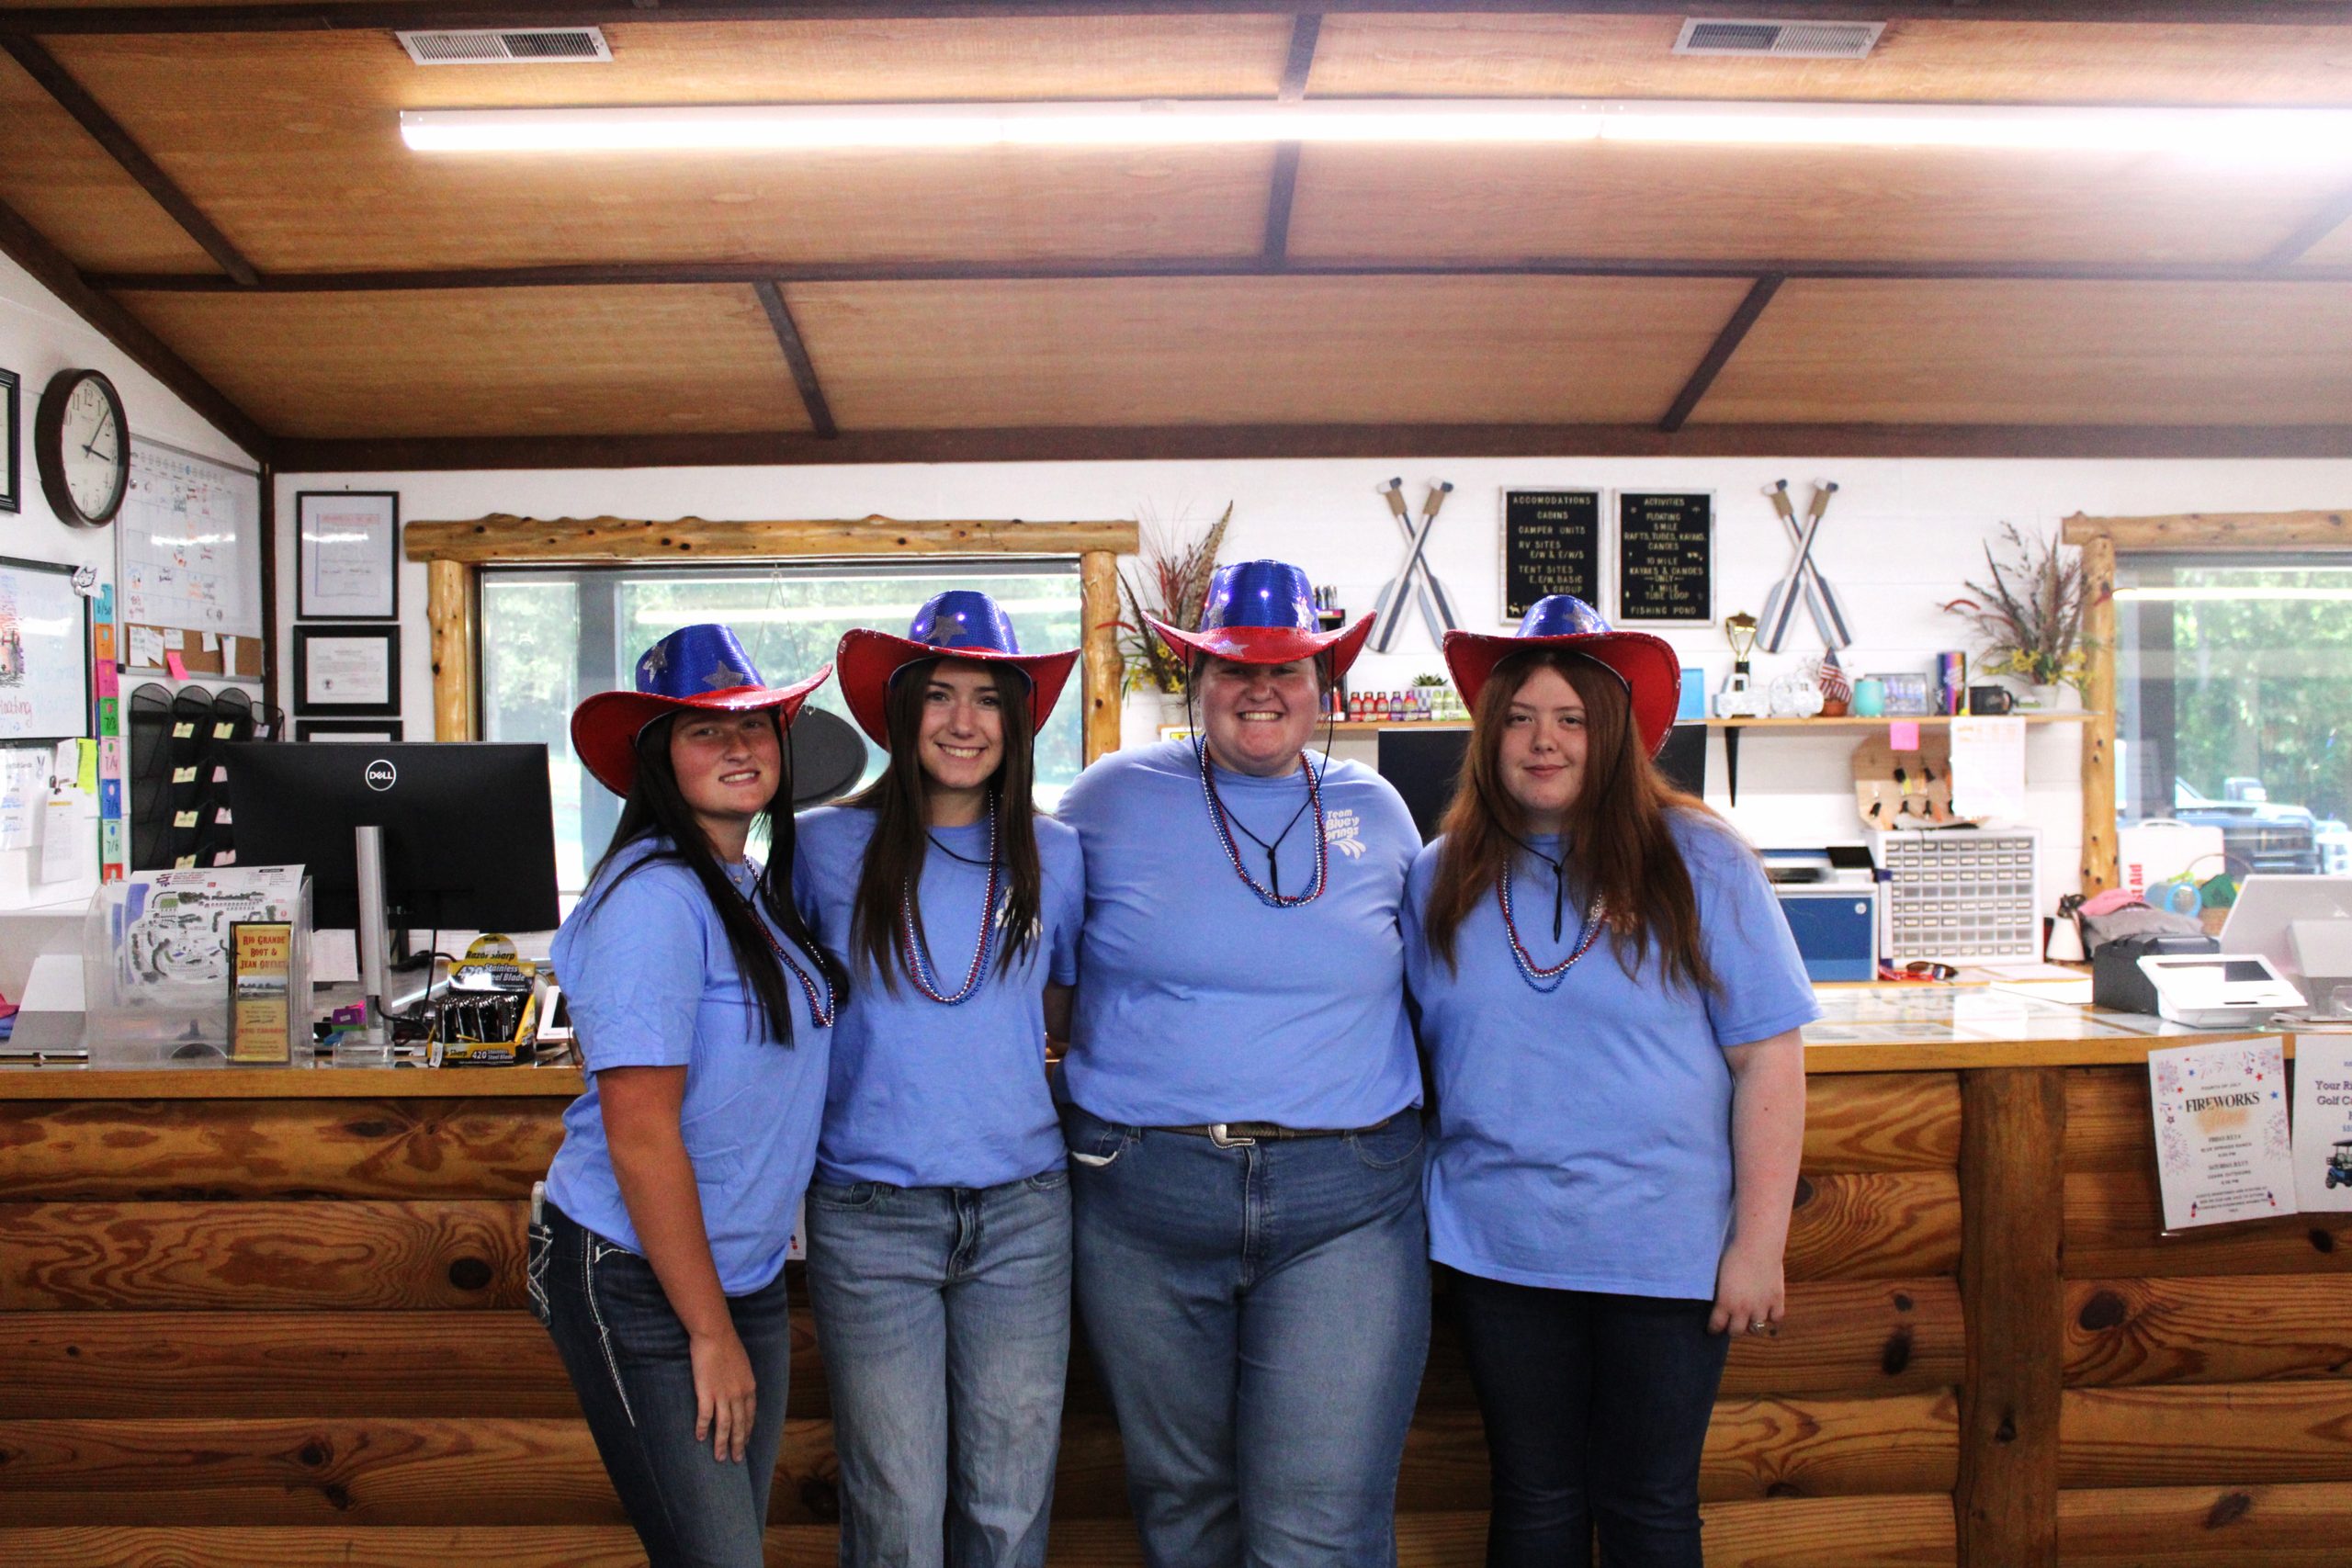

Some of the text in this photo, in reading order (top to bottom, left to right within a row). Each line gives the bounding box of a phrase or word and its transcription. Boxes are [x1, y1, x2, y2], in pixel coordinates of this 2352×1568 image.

[1512, 496, 1591, 505] ACCOMODATIONS
[1644, 498, 1685, 506] ACTIVITIES
[1537, 511, 1569, 520] CABINS
[1646, 513, 1681, 521] FLOATING
[1518, 525, 1586, 535] CAMPER UNITS
[1660, 523, 1678, 531] MILE
[1518, 540, 1561, 549] RV SITES
[1647, 542, 1679, 550] CANOES
[1530, 550, 1585, 558] E/W & E/W/S
[1657, 558, 1678, 566] MILE
[1518, 565, 1574, 574] TENT SITES
[1671, 567, 1703, 576] CANOES
[1556, 575, 1583, 583] BASIC
[1553, 585, 1583, 593] GROUP
[1669, 591, 1690, 600] LOOP
[1631, 606, 1696, 615] FISHING POND
[368, 771, 393, 780] DELL
[1327, 809, 1353, 819] Team
[257, 935, 287, 945] GRANDE
[250, 947, 278, 958] BOOT &
[465, 951, 489, 960] Razor
[239, 960, 257, 970] JEAN
[484, 963, 519, 973] Stainless
[503, 973, 526, 981] Blade
[471, 1050, 487, 1059] 420
[2314, 1080, 2341, 1090] Your
[2186, 1091, 2260, 1112] FIREWORKS
[2316, 1095, 2340, 1106] Golf
